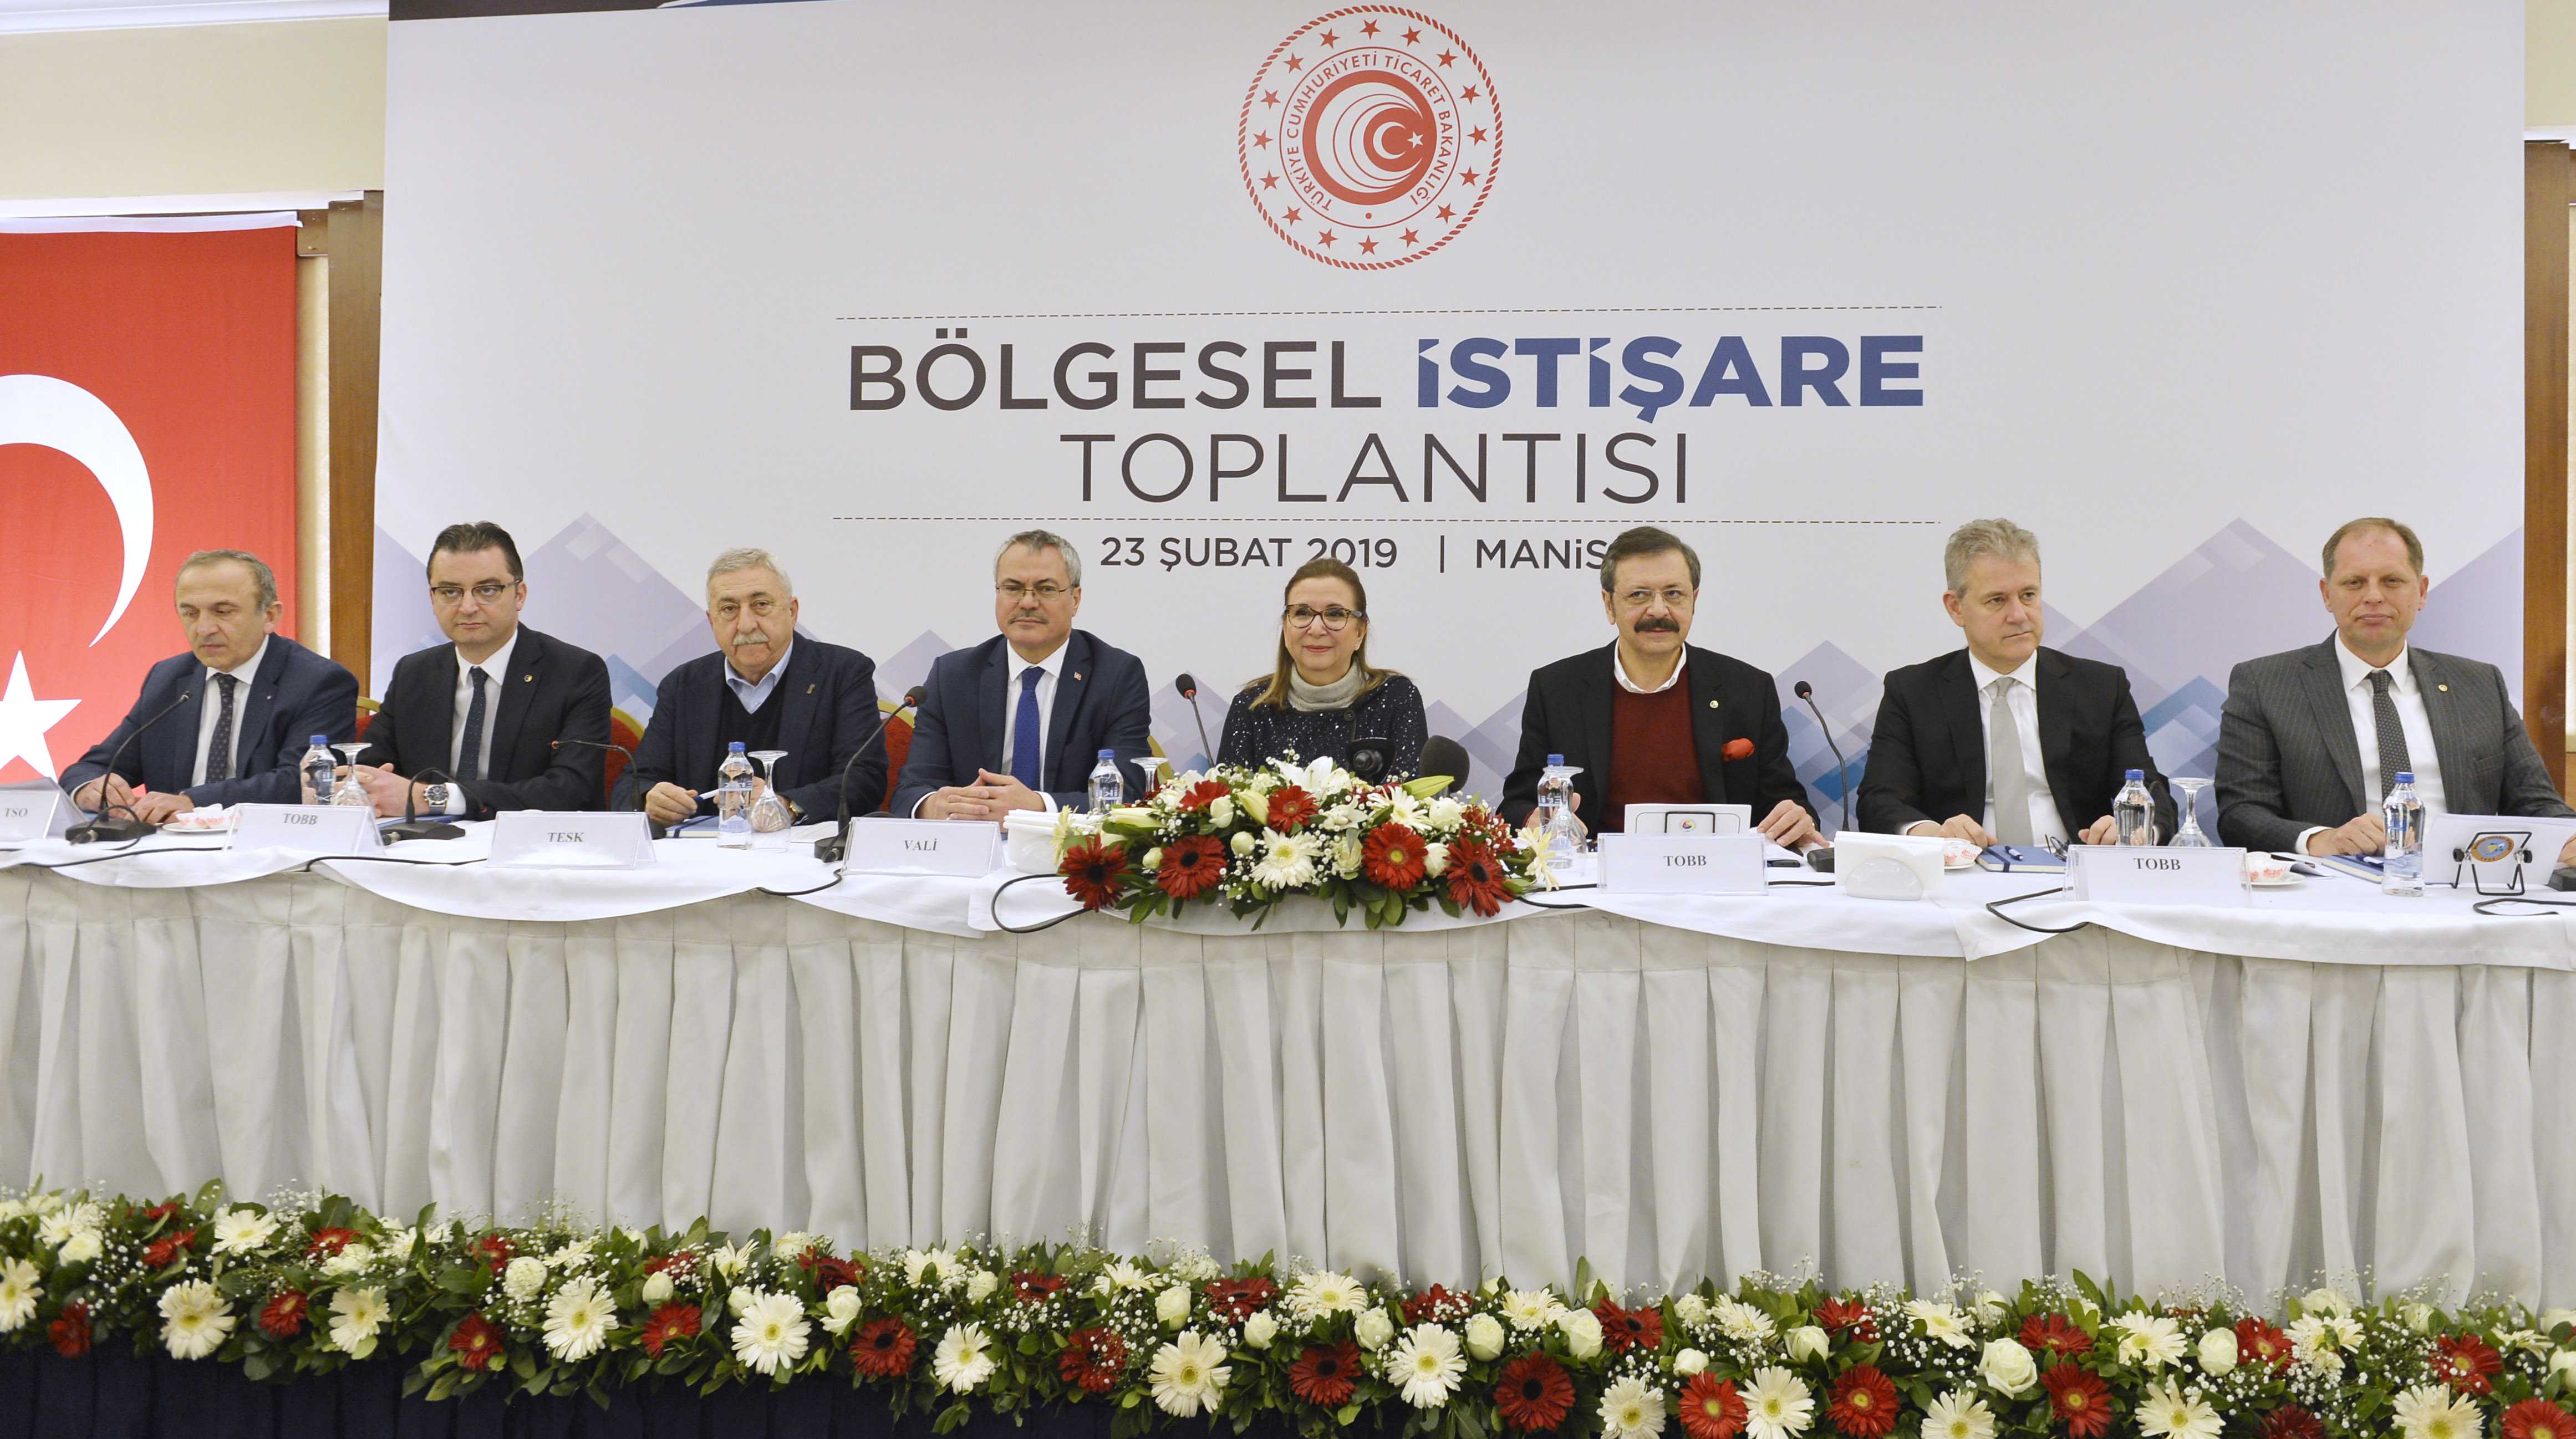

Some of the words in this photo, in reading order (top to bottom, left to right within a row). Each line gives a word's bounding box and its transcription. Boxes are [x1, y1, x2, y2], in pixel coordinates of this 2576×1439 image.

[1286, 50, 1377, 139] CUMHURİYETİ
[1384, 55, 1446, 105] TİCARET
[1410, 110, 1453, 205] BAKANLIĞI
[1287, 147, 1332, 211] TÜRKİYE
[850, 328, 1382, 411] BÖLGESEL
[1060, 432, 1686, 505] TOPLANTISI
[1100, 537, 1144, 567] 23
[1159, 537, 1292, 573] ŞUBAT
[1307, 538, 1397, 568] 2019
[5, 807, 28, 817] TSO
[283, 813, 318, 826] TOBB
[547, 831, 585, 843] TESK
[904, 838, 938, 852] VALİ
[1663, 854, 1708, 868] TOBB
[2133, 857, 2182, 871] TOBB
